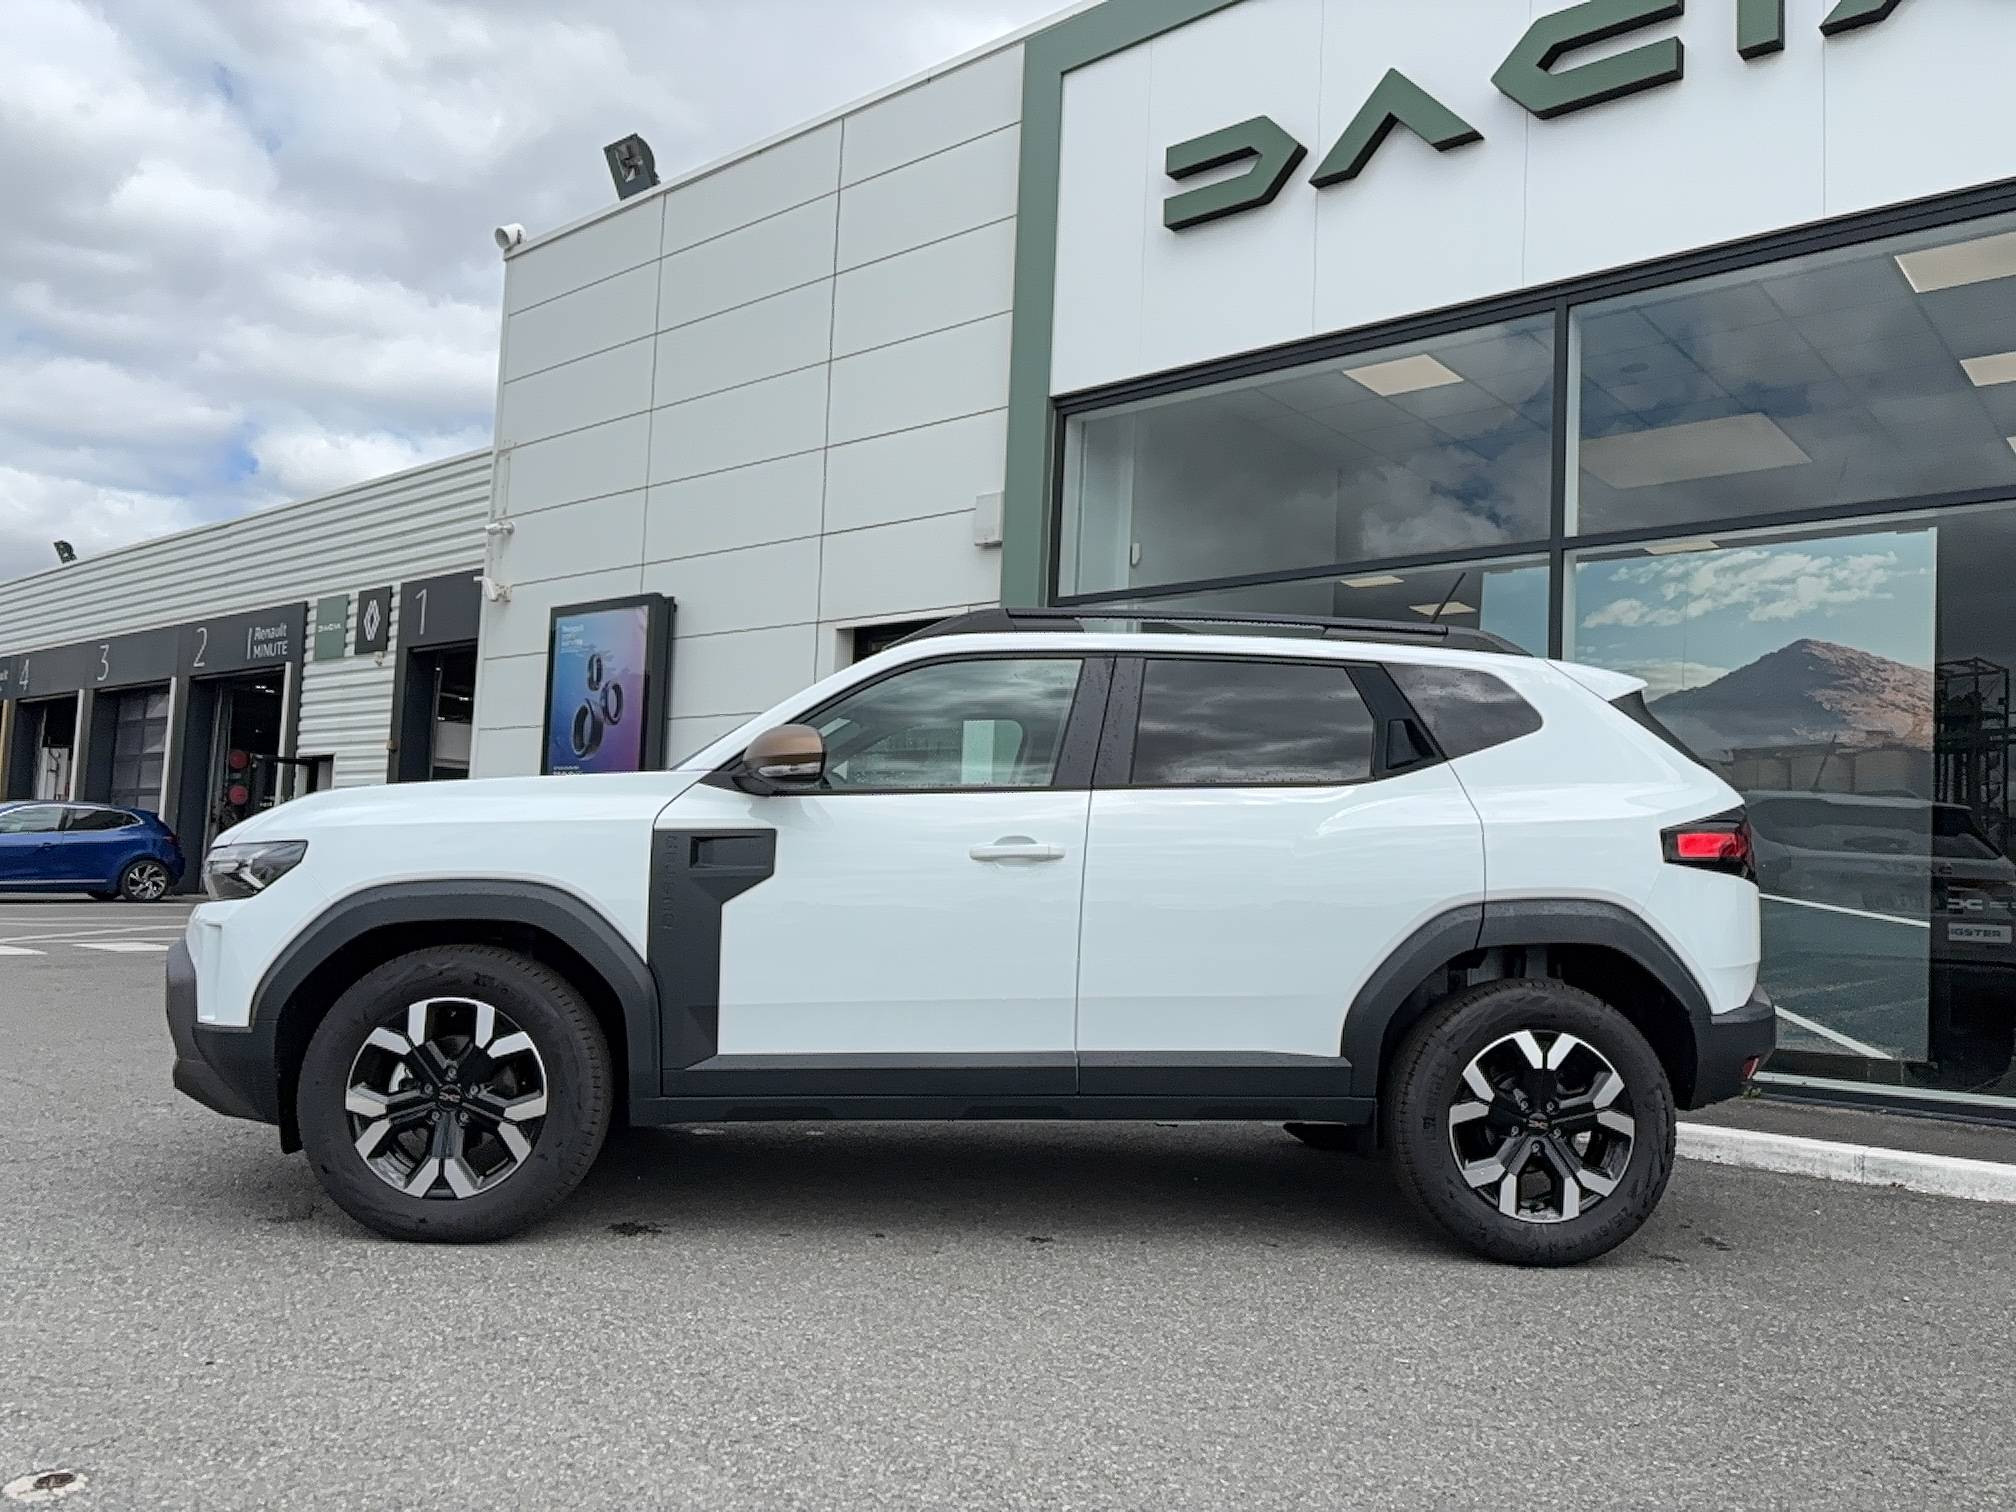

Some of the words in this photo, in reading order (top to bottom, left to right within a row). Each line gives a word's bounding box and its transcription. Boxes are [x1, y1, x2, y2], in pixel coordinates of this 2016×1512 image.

[1164, 0, 1903, 232] DAC
[415, 588, 428, 636] 1
[193, 626, 208, 668] 2
[254, 621, 288, 641] Renault
[96, 644, 110, 681] 3
[253, 640, 289, 659] MINUTE
[19, 658, 30, 691] 4
[1950, 926, 2001, 937] IGSTER
